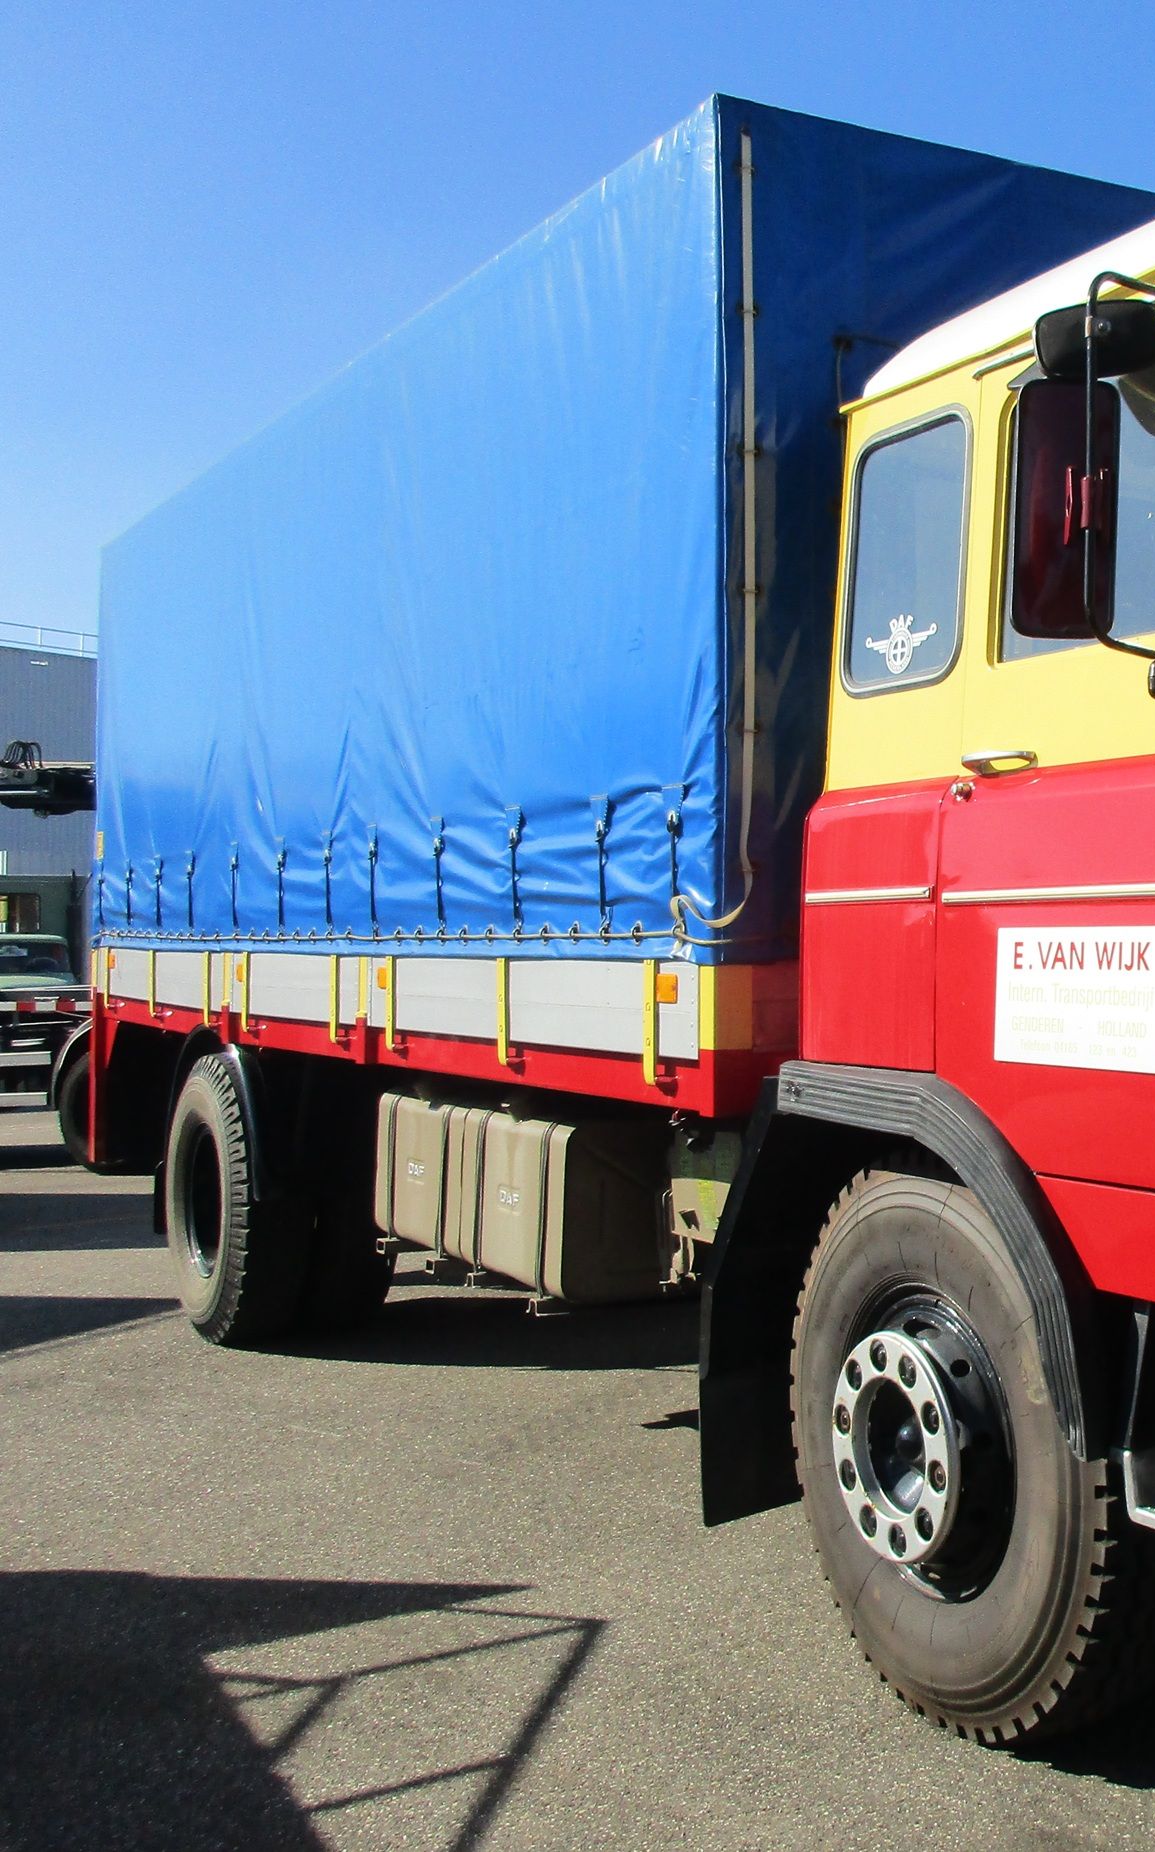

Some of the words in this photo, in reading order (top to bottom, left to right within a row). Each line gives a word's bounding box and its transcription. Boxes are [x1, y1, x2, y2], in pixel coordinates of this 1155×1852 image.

[889, 614, 914, 634] DAF
[1095, 941, 1151, 971] WIJK
[1097, 1020, 1148, 1038] HOLLAND
[408, 1162, 425, 1177] DAF
[499, 1189, 520, 1207] DAF
